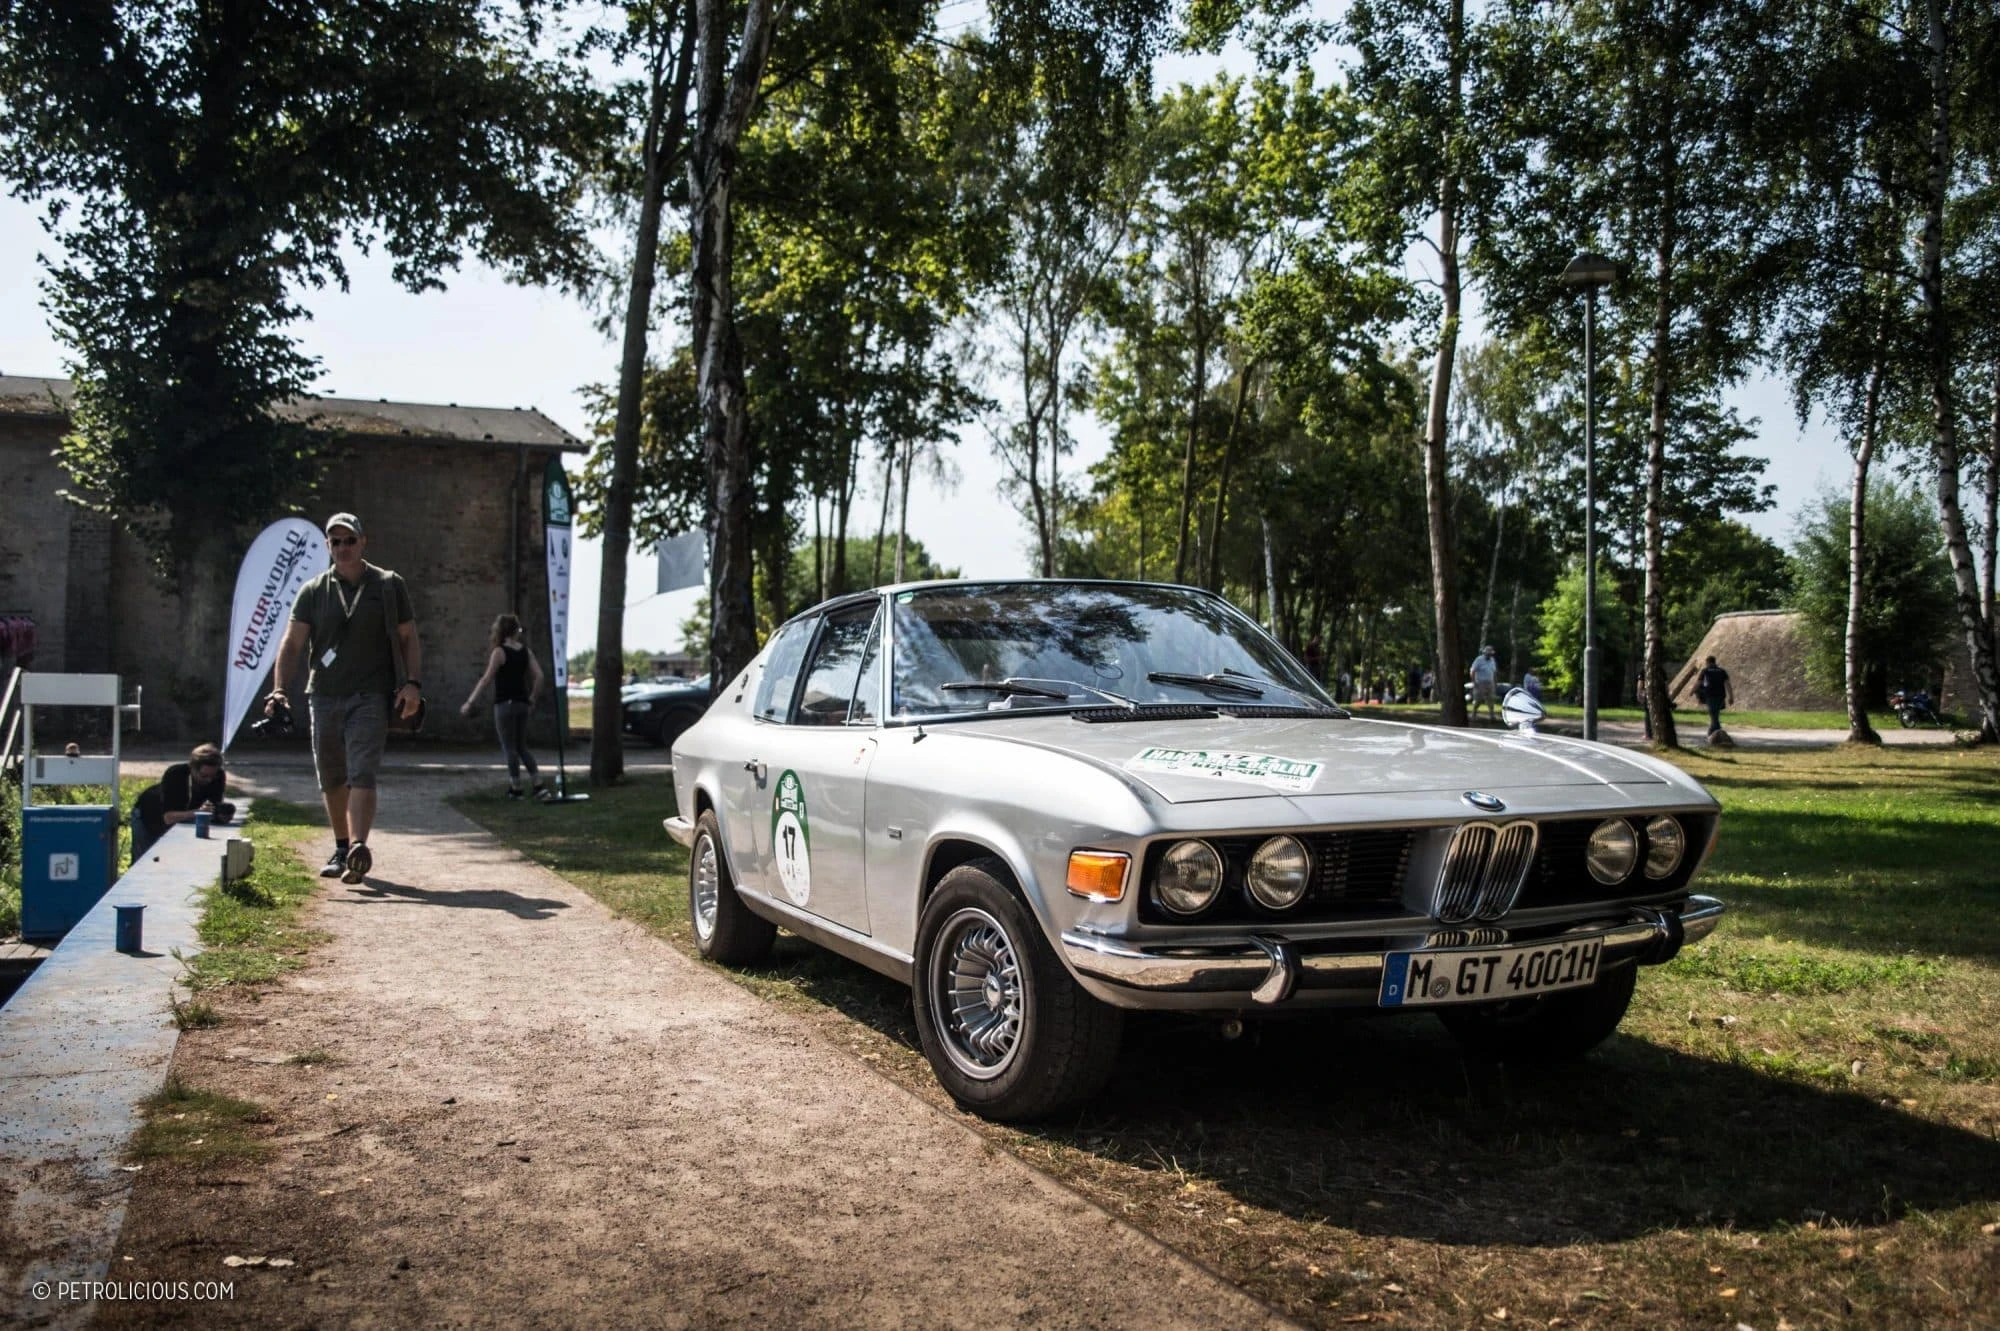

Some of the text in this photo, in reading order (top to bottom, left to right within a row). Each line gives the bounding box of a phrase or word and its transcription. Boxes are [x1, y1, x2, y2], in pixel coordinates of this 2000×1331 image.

[233, 529, 301, 671] MOTORWORLD
[243, 600, 283, 671] Classics
[782, 824, 796, 861] 17
[1406, 942, 1600, 999] M GT 4001H
